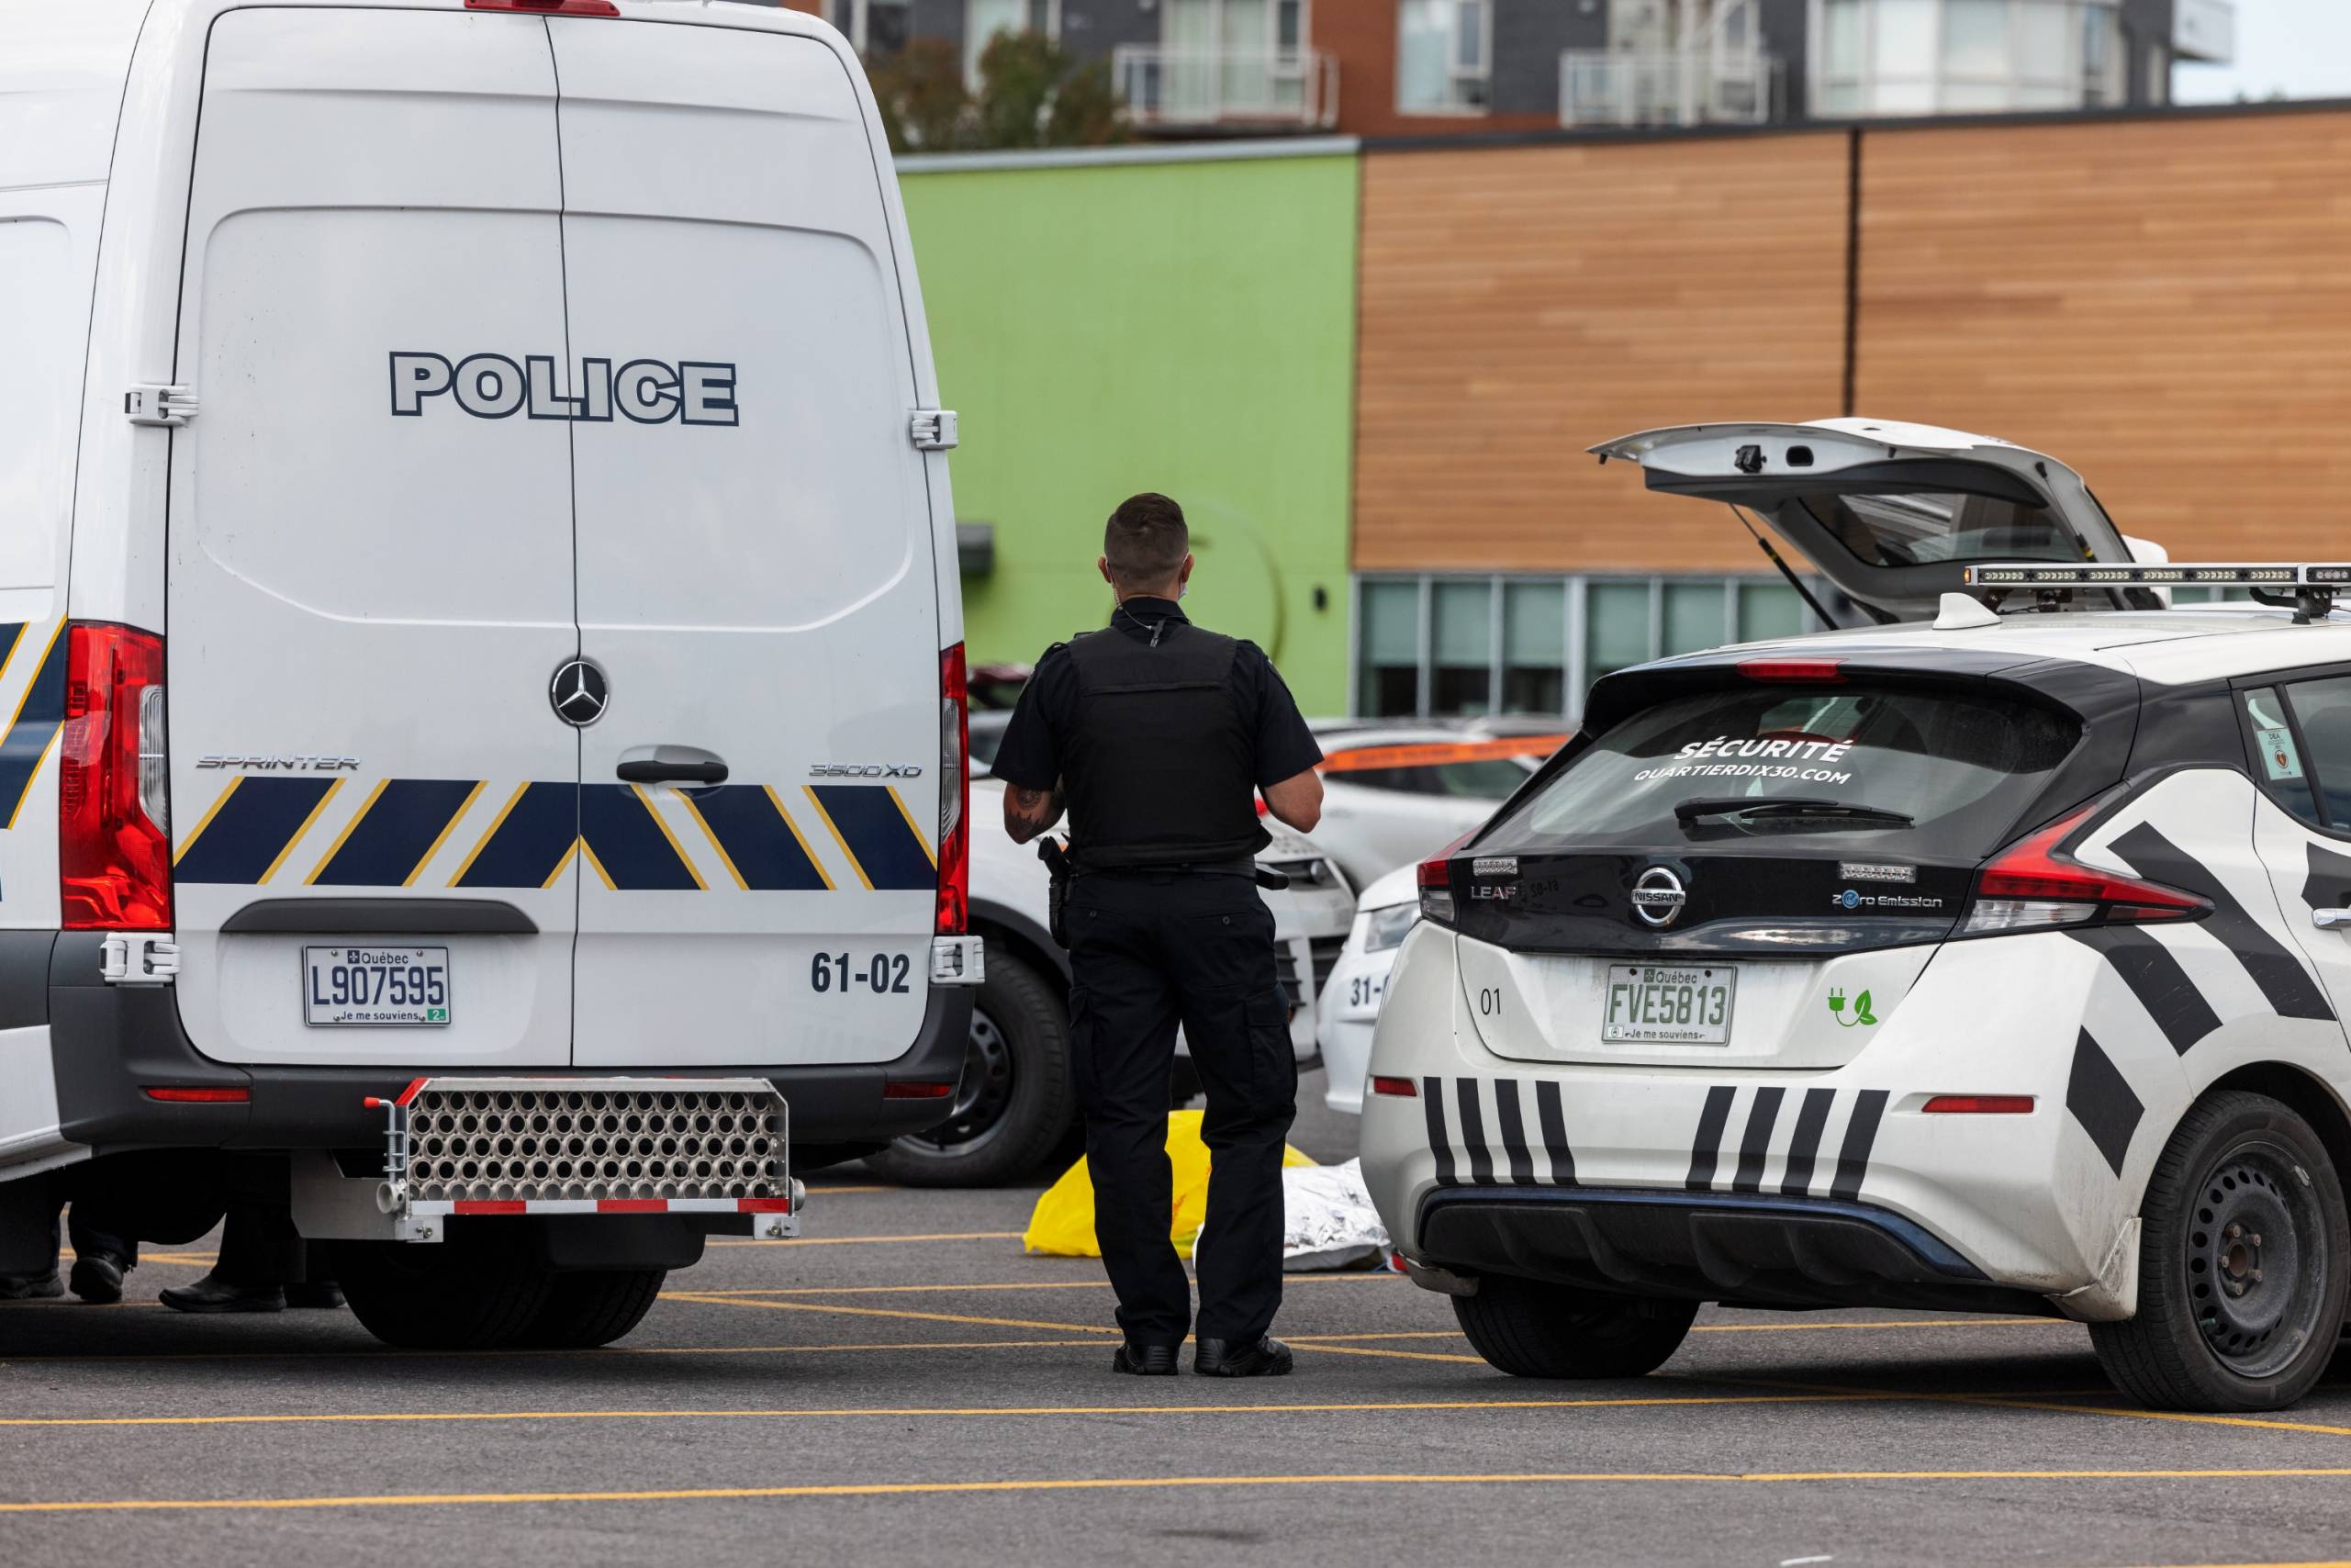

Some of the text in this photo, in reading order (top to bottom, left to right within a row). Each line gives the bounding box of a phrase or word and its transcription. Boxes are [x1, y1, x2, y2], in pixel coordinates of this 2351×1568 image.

[389, 352, 739, 426] POLICE
[1674, 735, 1853, 763] SÉCURITÉ
[196, 754, 361, 771] SPRINTER
[809, 763, 923, 778] 3500XD
[1634, 764, 1852, 785] QUARTIERDIX30.COM
[1471, 886, 1517, 900] LEAF
[1635, 892, 1678, 902] NISSAN
[1877, 895, 1943, 908] Emission
[362, 952, 409, 964] Québec
[812, 952, 910, 993] 61-02
[1655, 970, 1697, 985] Québec
[312, 966, 444, 1005] L907595
[1351, 974, 1389, 1007] 31-
[1481, 988, 1501, 1015] 01
[1609, 984, 1727, 1025] FVE5813
[341, 1011, 353, 1020] Je
[374, 1011, 419, 1020] souviens
[1630, 1029, 1698, 1039] Je me souviens
